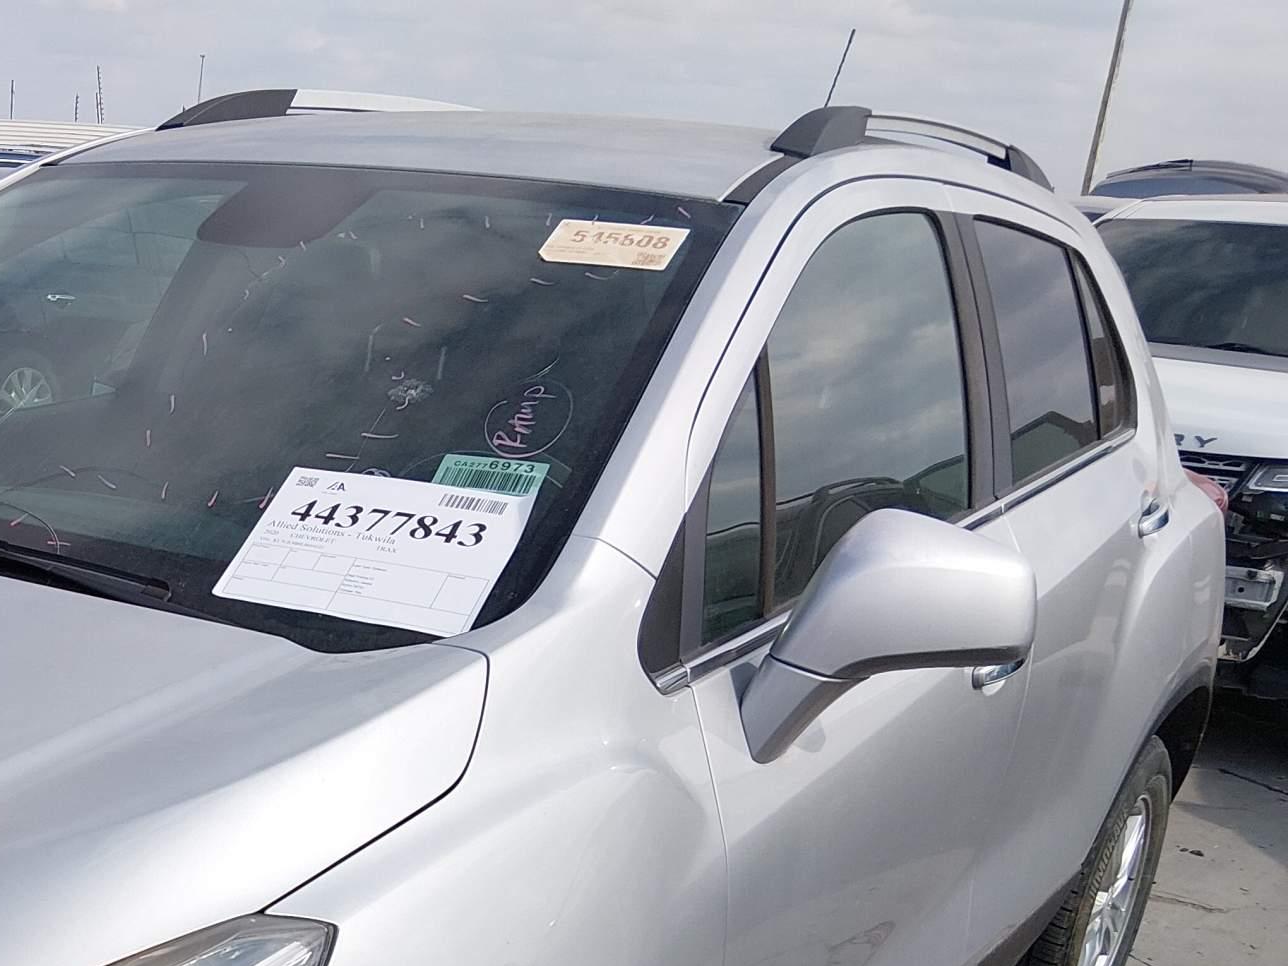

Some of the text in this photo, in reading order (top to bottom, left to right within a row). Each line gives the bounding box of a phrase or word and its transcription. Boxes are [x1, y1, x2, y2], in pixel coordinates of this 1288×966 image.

[264, 519, 300, 531] Allied
[300, 523, 345, 538] Solutions
[355, 531, 396, 545] Tukwila
[290, 499, 488, 548] 44377843
